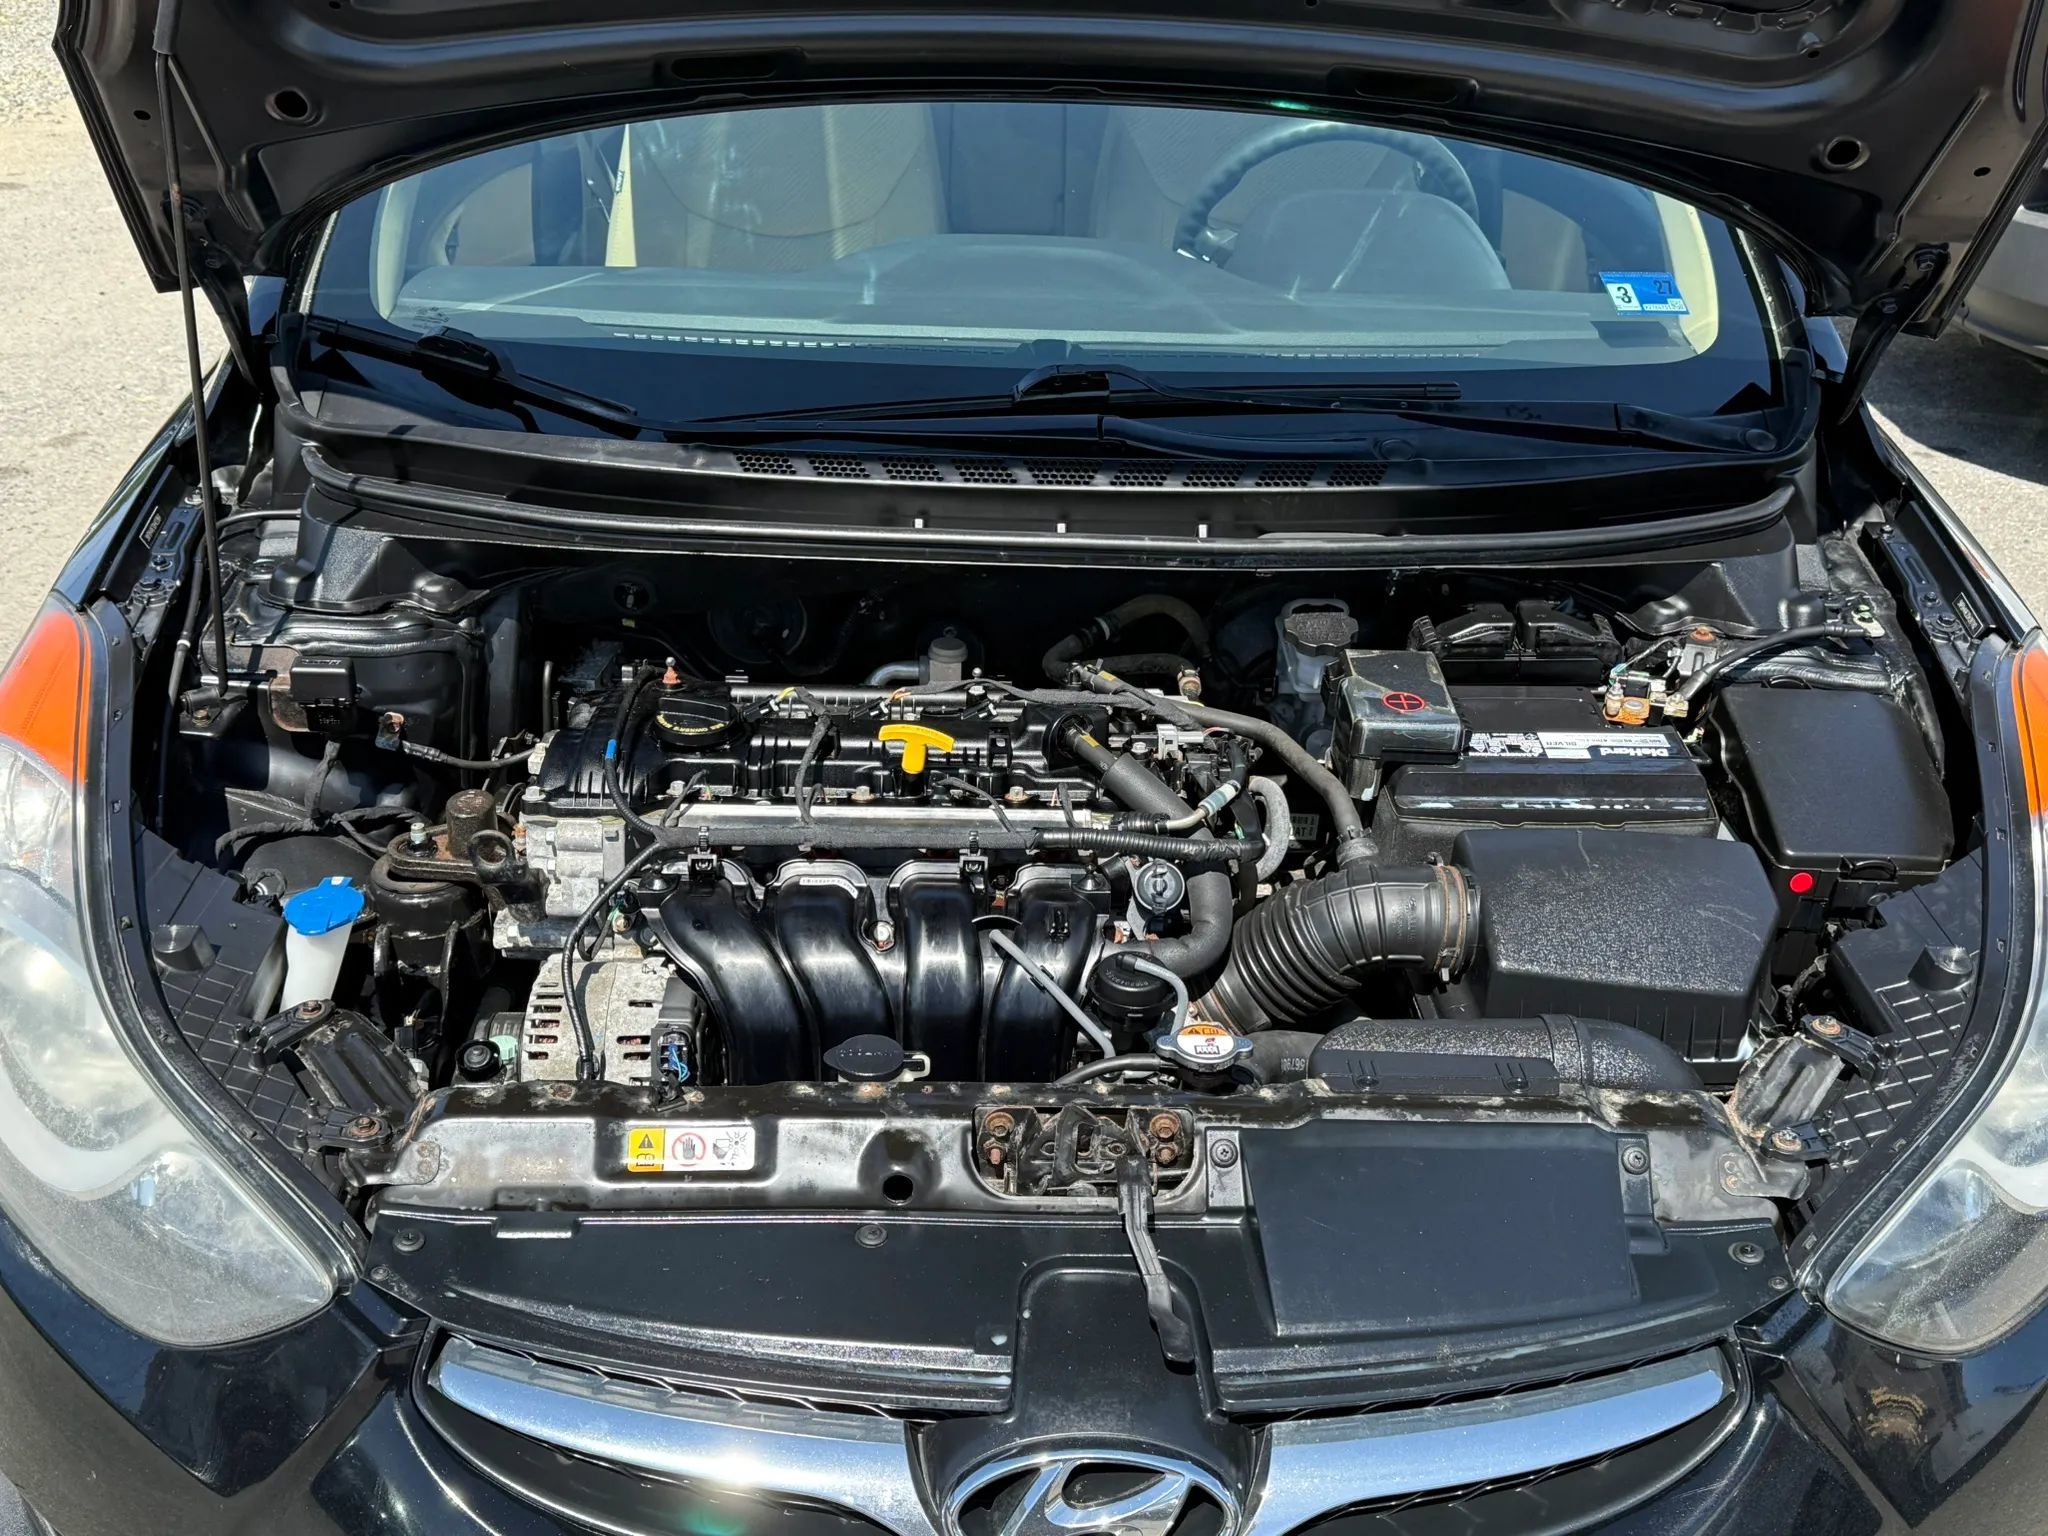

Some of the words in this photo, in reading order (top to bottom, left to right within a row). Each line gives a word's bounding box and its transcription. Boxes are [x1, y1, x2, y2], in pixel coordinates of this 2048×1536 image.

[1653, 280, 1673, 294] 27
[1617, 286, 1632, 304] 3
[1599, 747, 1669, 757] DieHard
